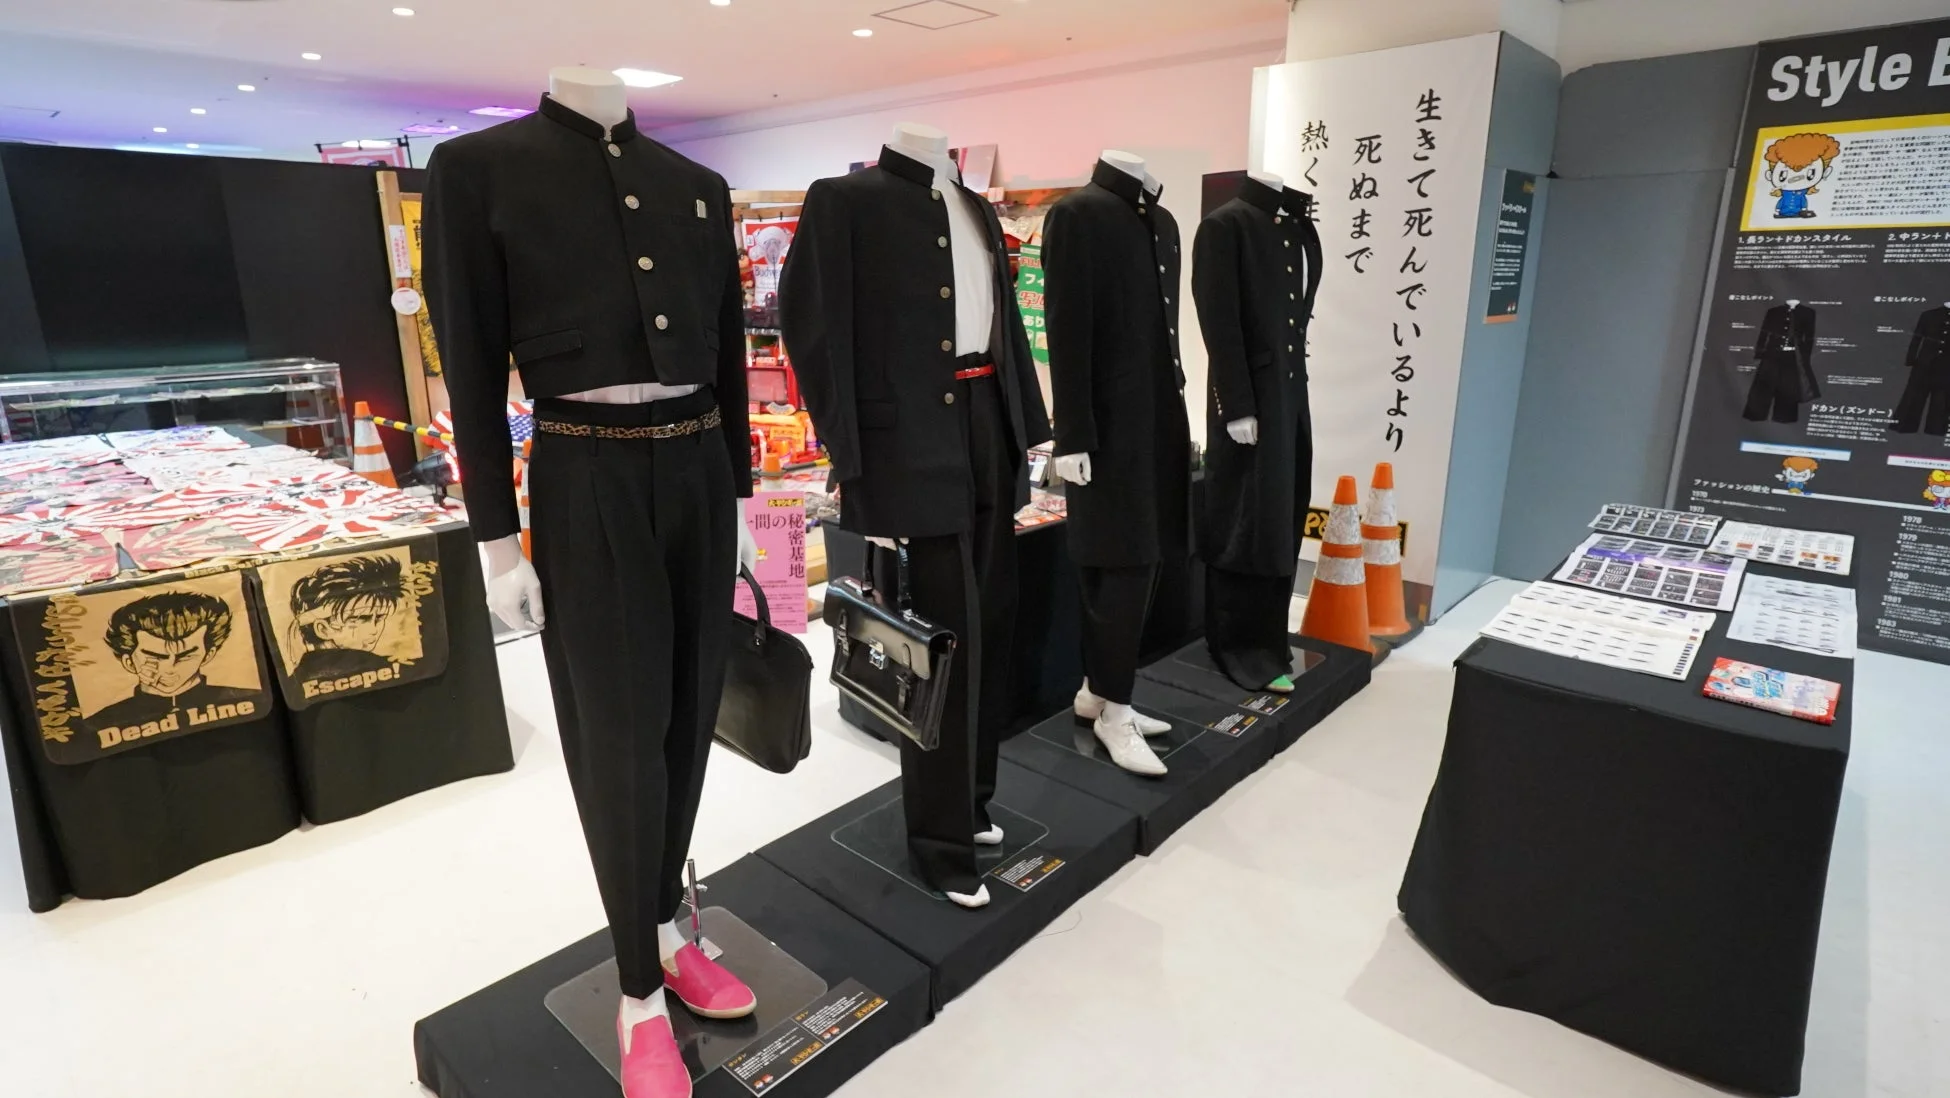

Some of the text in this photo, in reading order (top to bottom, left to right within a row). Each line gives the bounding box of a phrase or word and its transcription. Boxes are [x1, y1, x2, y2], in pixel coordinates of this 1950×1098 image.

[1767, 45, 1912, 107] Style
[1345, 134, 1382, 274] 死ぬまで
[1385, 88, 1442, 452] 生きて死んでいるより
[788, 513, 805, 578] 秘密基地
[303, 662, 402, 699] Escape!
[98, 700, 256, 749] Dead Line
